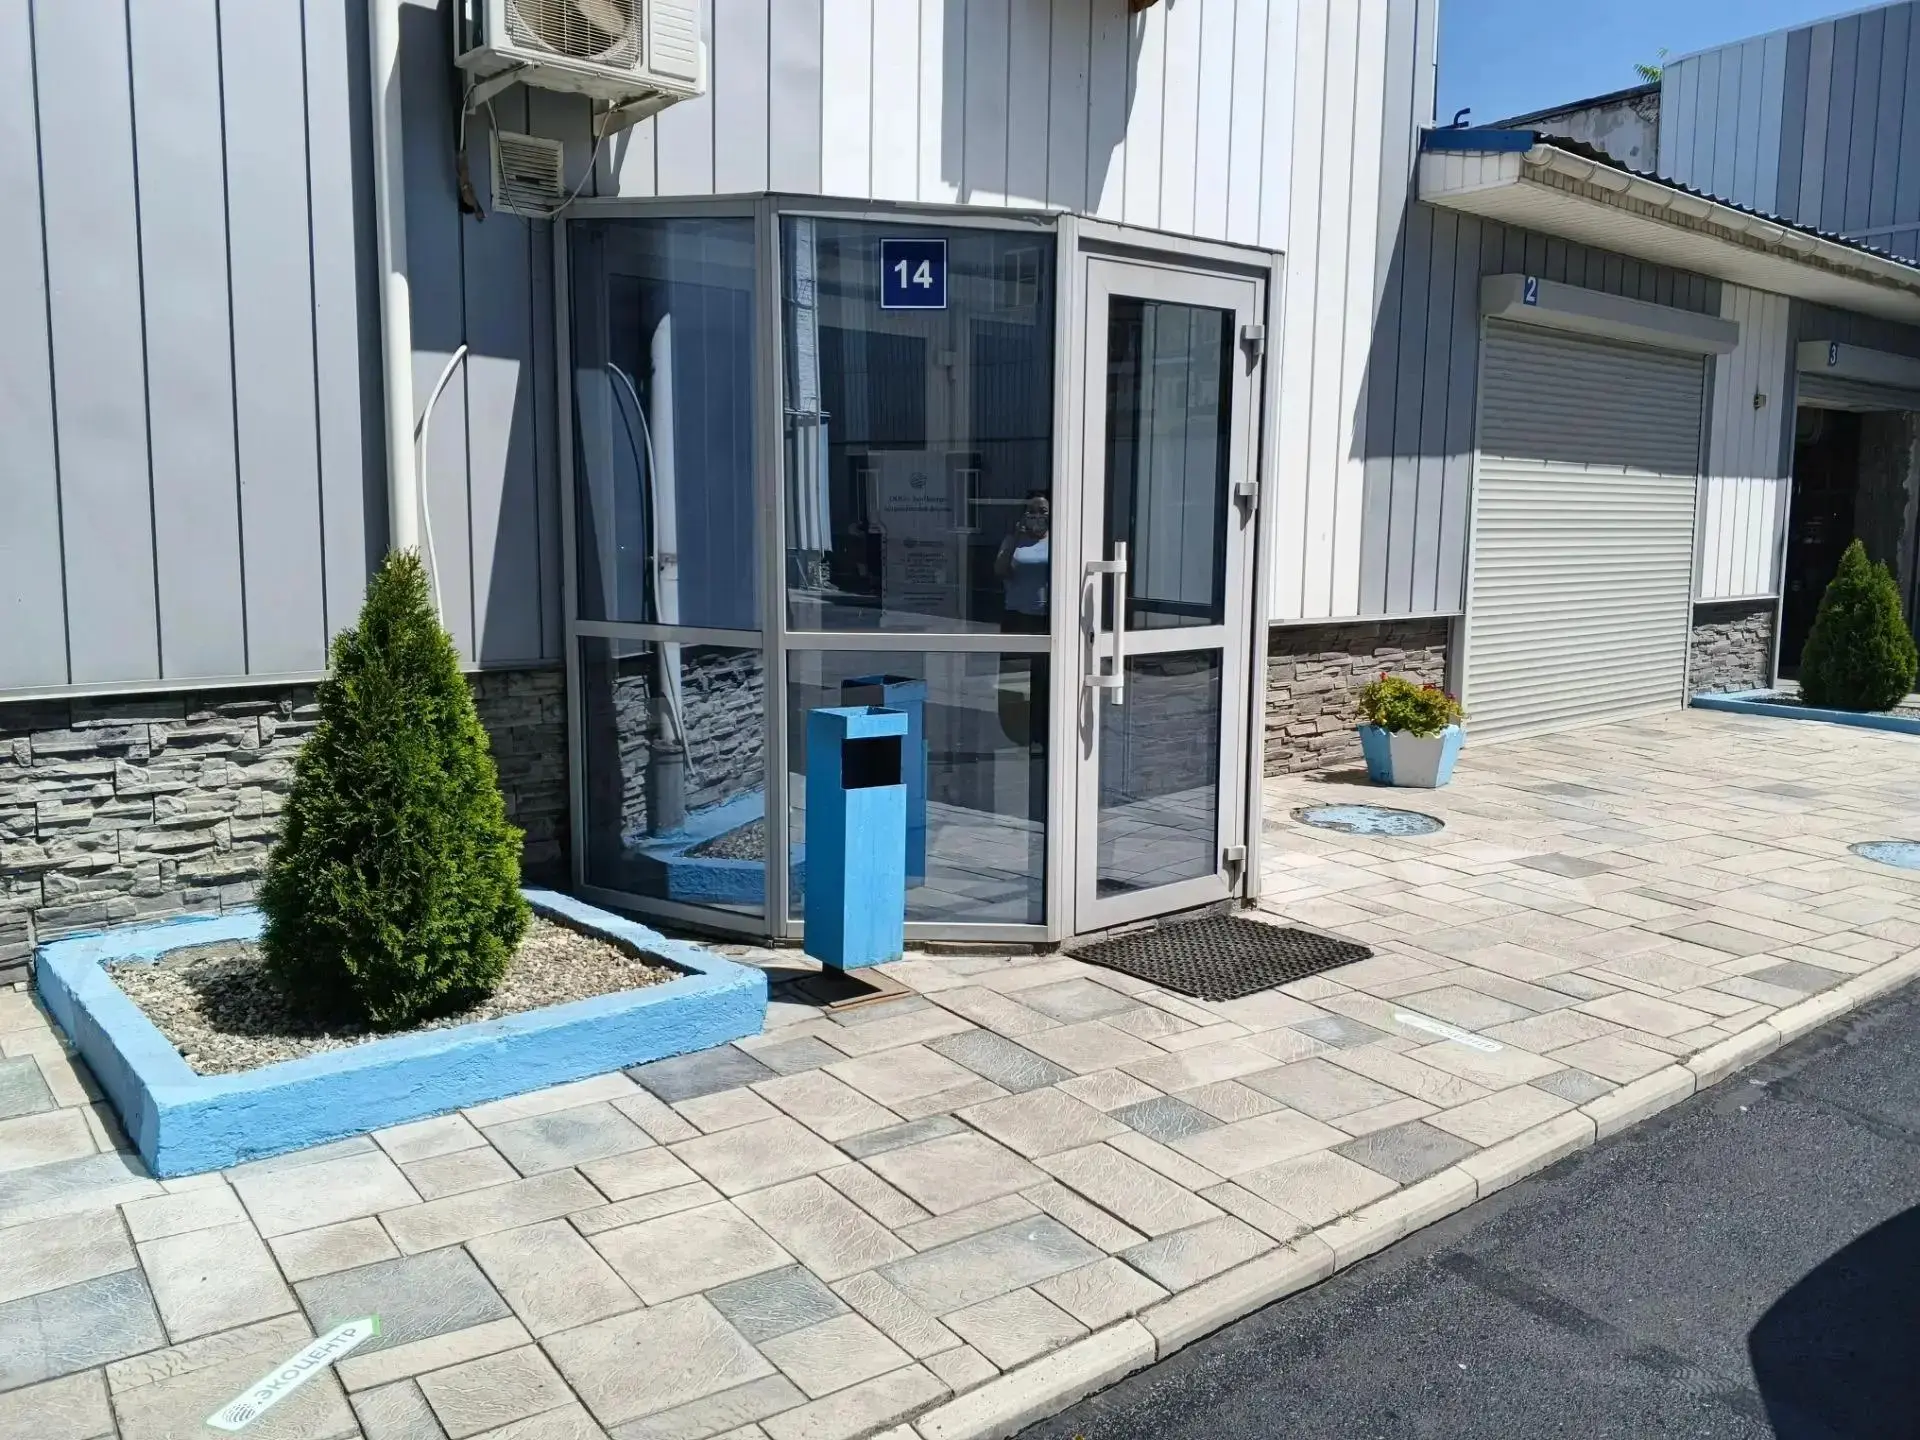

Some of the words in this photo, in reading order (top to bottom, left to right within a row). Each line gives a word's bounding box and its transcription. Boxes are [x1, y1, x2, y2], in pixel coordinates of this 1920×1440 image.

[894, 259, 933, 289] 14
[1526, 276, 1537, 302] 2
[1830, 344, 1837, 364] 3
